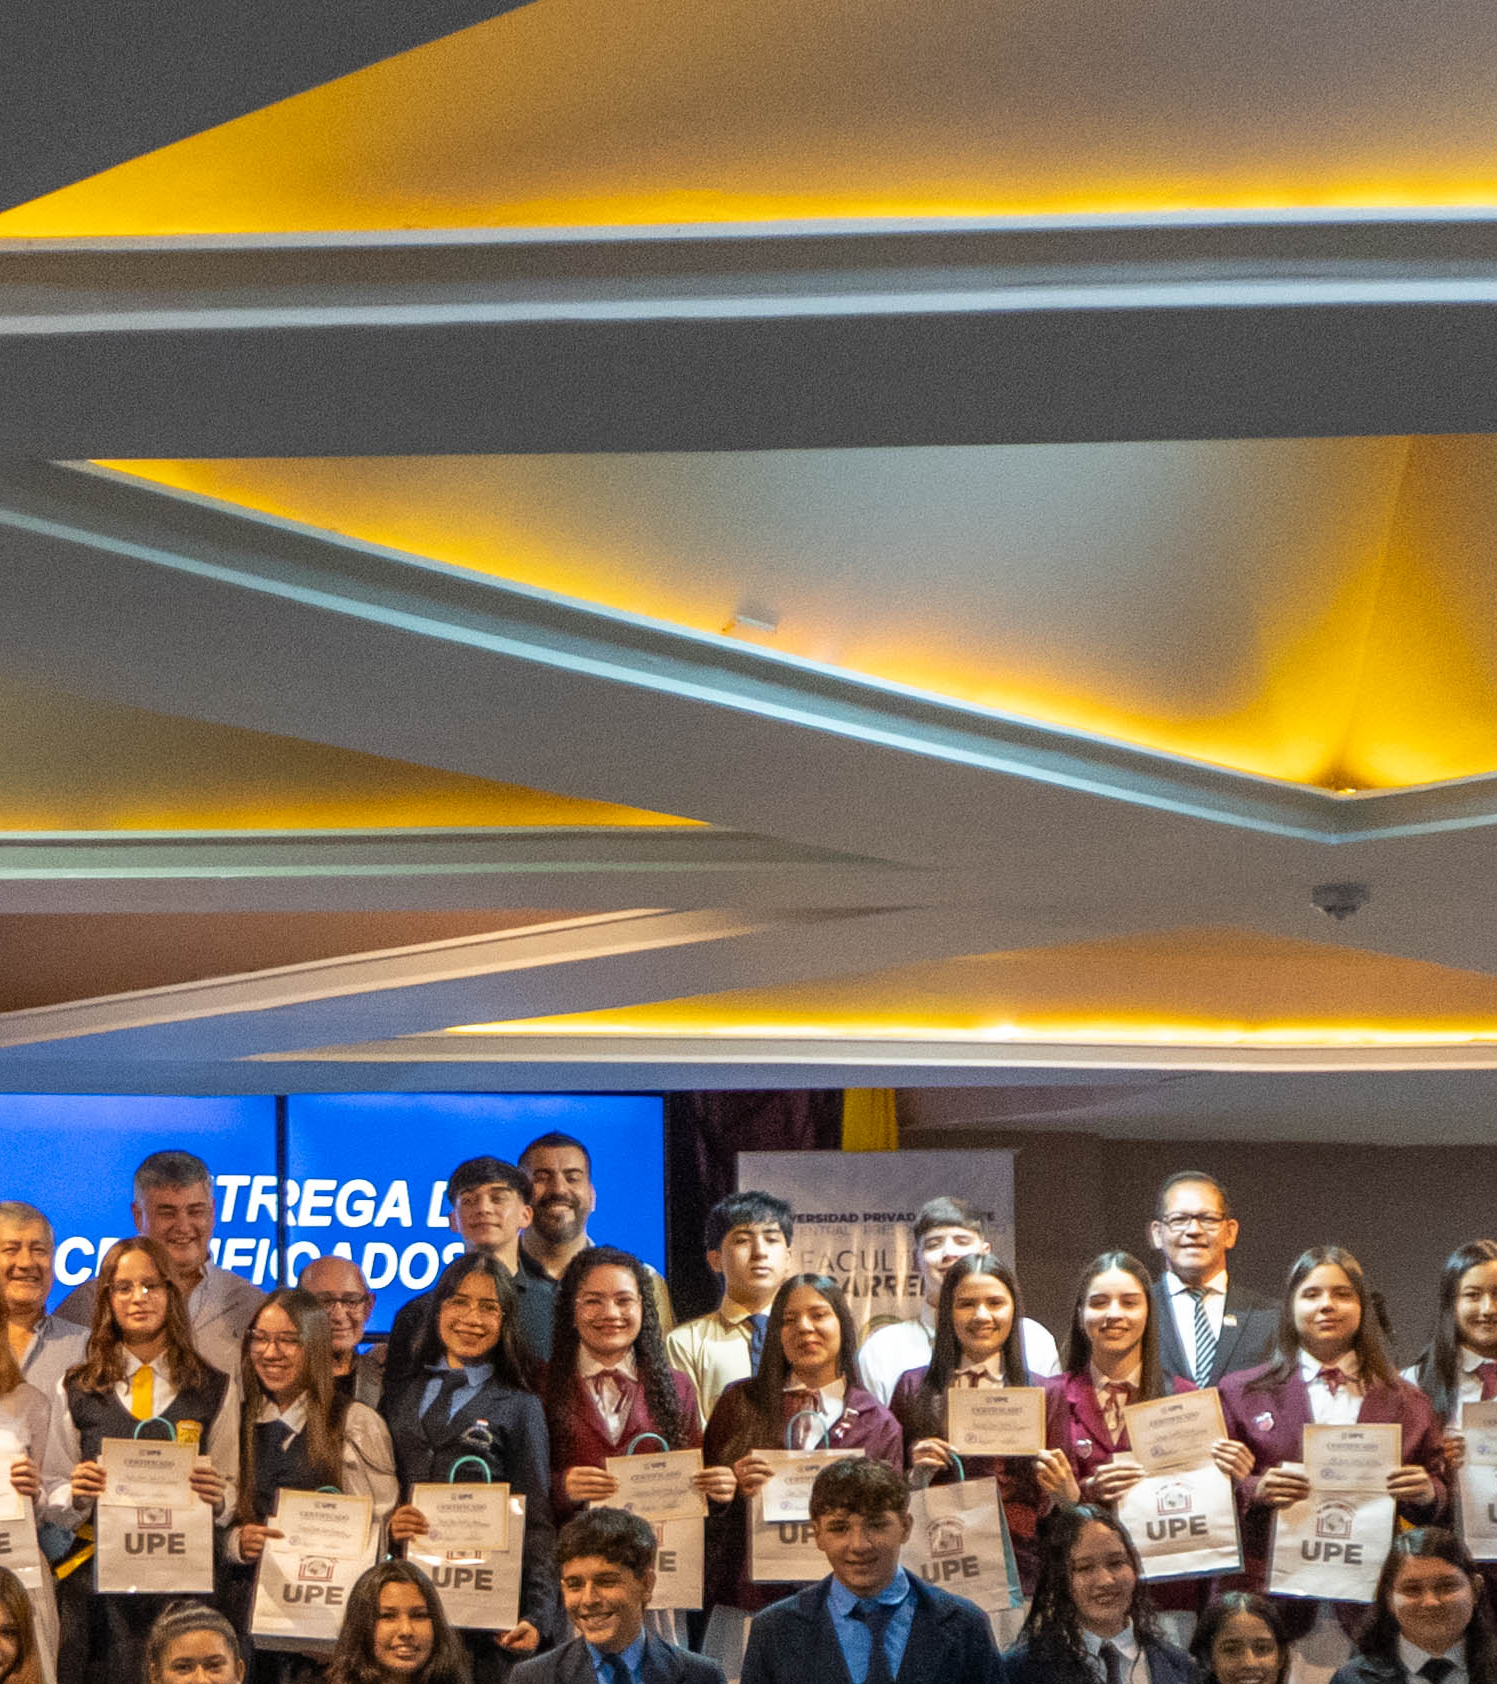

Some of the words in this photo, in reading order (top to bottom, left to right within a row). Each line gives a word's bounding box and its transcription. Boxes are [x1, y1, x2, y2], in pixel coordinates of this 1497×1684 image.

[212, 1175, 410, 1228] TREGA
[791, 1212, 859, 1224] VERSIDAD
[863, 1212, 916, 1223] PRIVAD
[779, 1524, 815, 1545] UP
[1146, 1515, 1208, 1541] UPE
[125, 1533, 185, 1555] UPE
[1301, 1540, 1363, 1565] UPE
[431, 1566, 493, 1592] UPE
[921, 1556, 979, 1584] UPE
[283, 1583, 344, 1606] UPE
